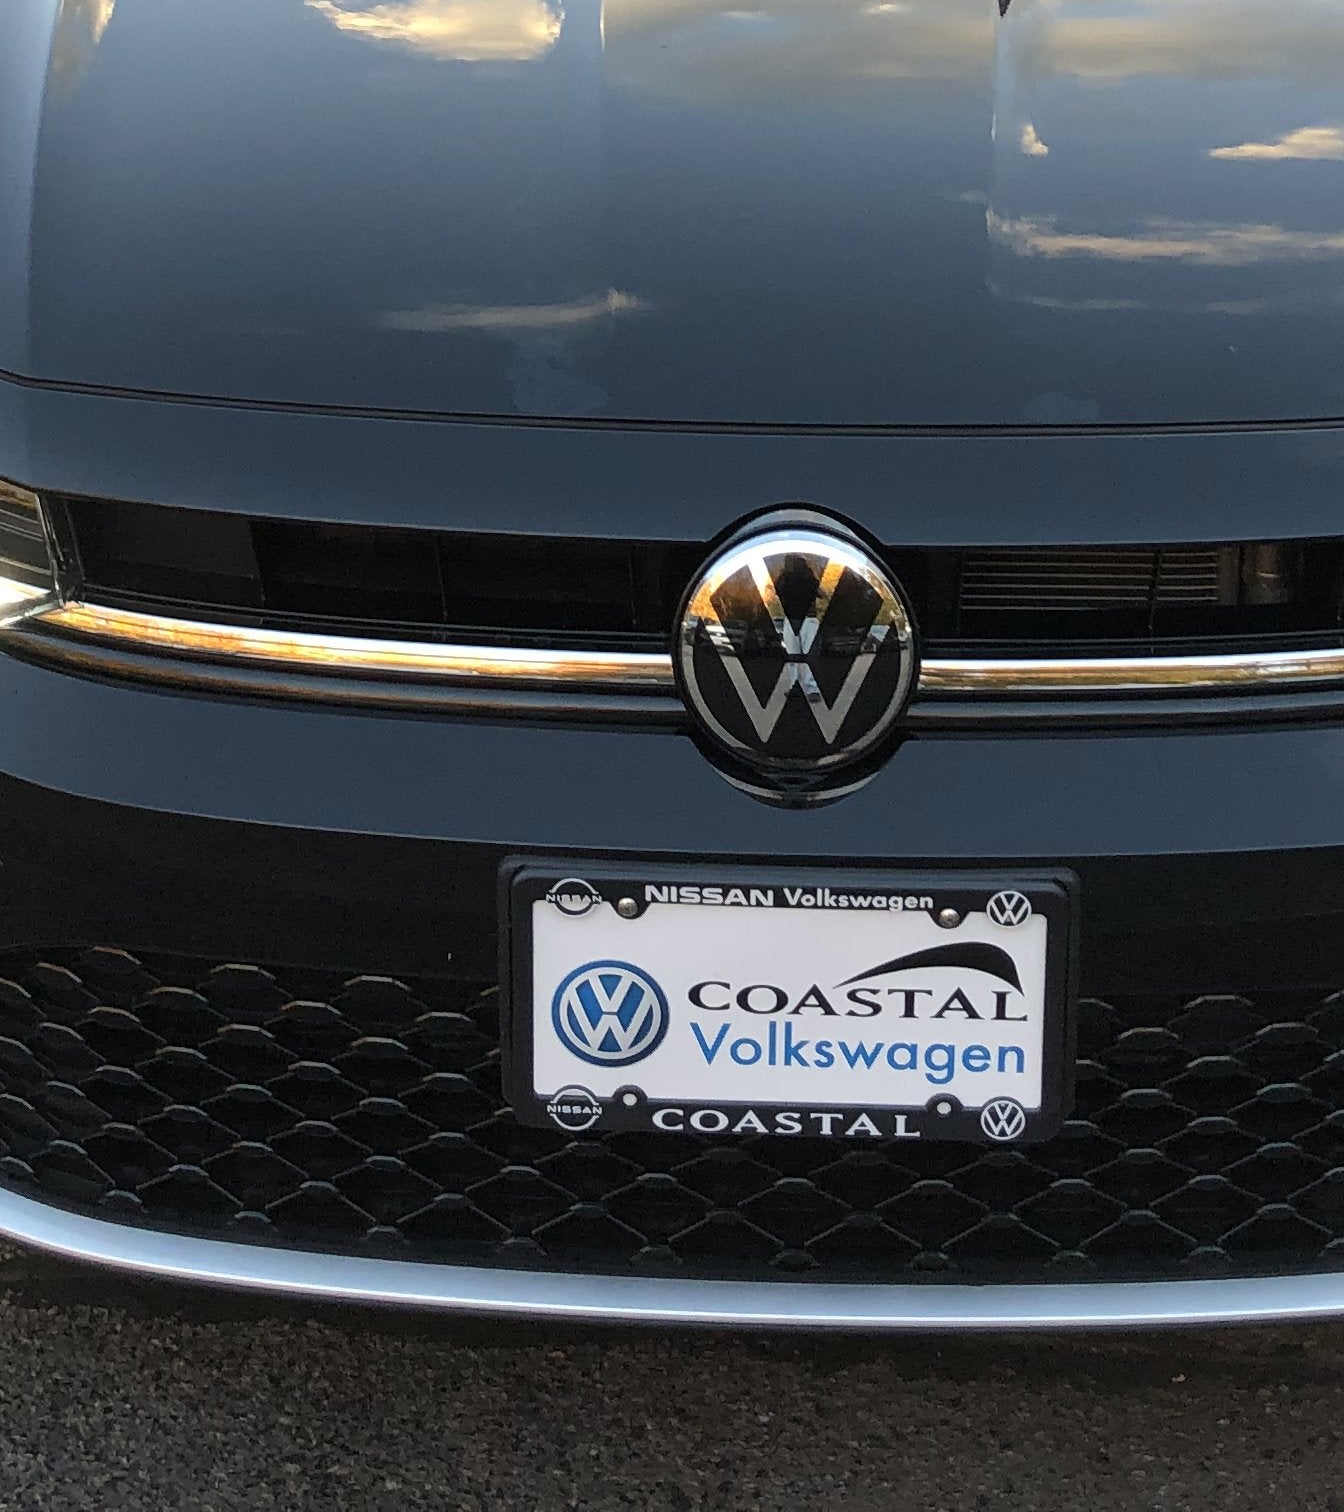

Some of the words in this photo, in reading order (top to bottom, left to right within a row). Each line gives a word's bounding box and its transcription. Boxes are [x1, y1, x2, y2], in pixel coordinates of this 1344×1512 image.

[644, 884, 774, 907] NISSAN
[783, 887, 934, 912] Volkswagen
[687, 980, 1028, 1022] COASTAL
[689, 1021, 1025, 1084] Volkswagen
[546, 1104, 603, 1115] NISSAN
[651, 1108, 921, 1137] COASTAL
